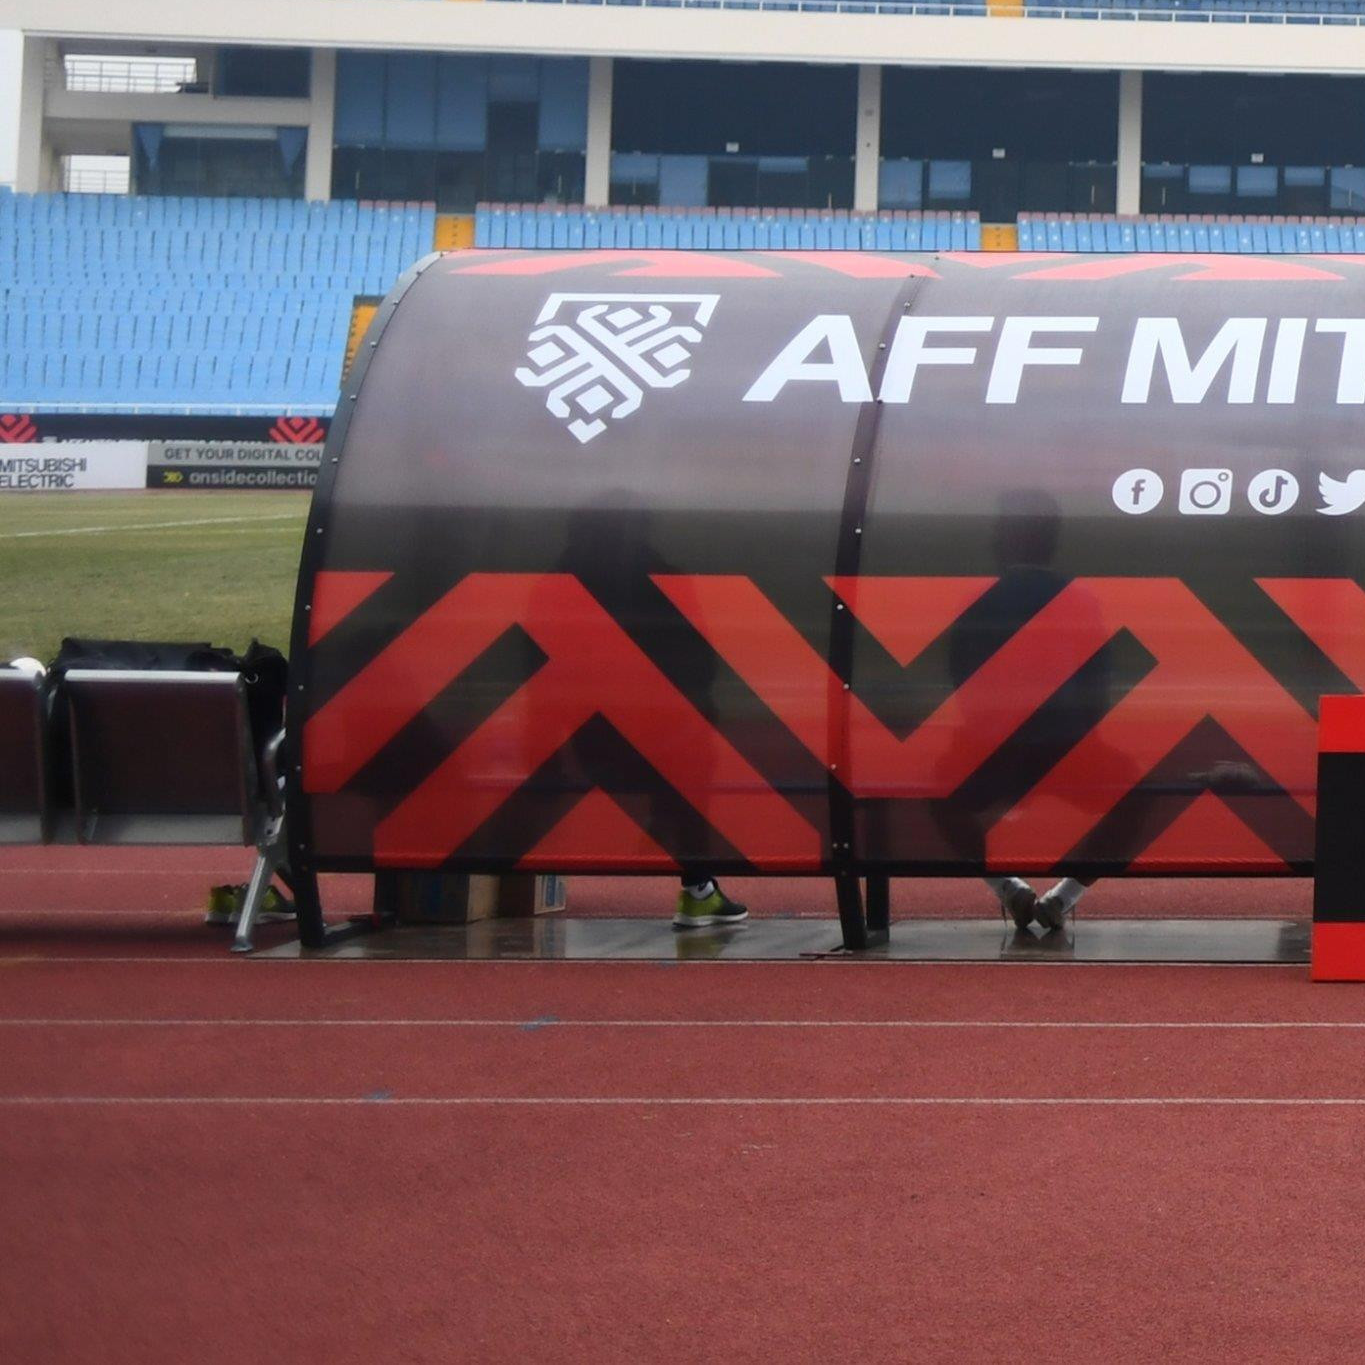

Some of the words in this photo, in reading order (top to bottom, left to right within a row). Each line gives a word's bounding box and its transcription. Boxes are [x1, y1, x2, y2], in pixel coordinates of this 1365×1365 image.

[743, 315, 1099, 403] AFF
[164, 448, 191, 460] GET
[195, 448, 234, 461] YOUR
[237, 448, 290, 461] DIGITAL
[0, 458, 86, 472] MITSUBISHI
